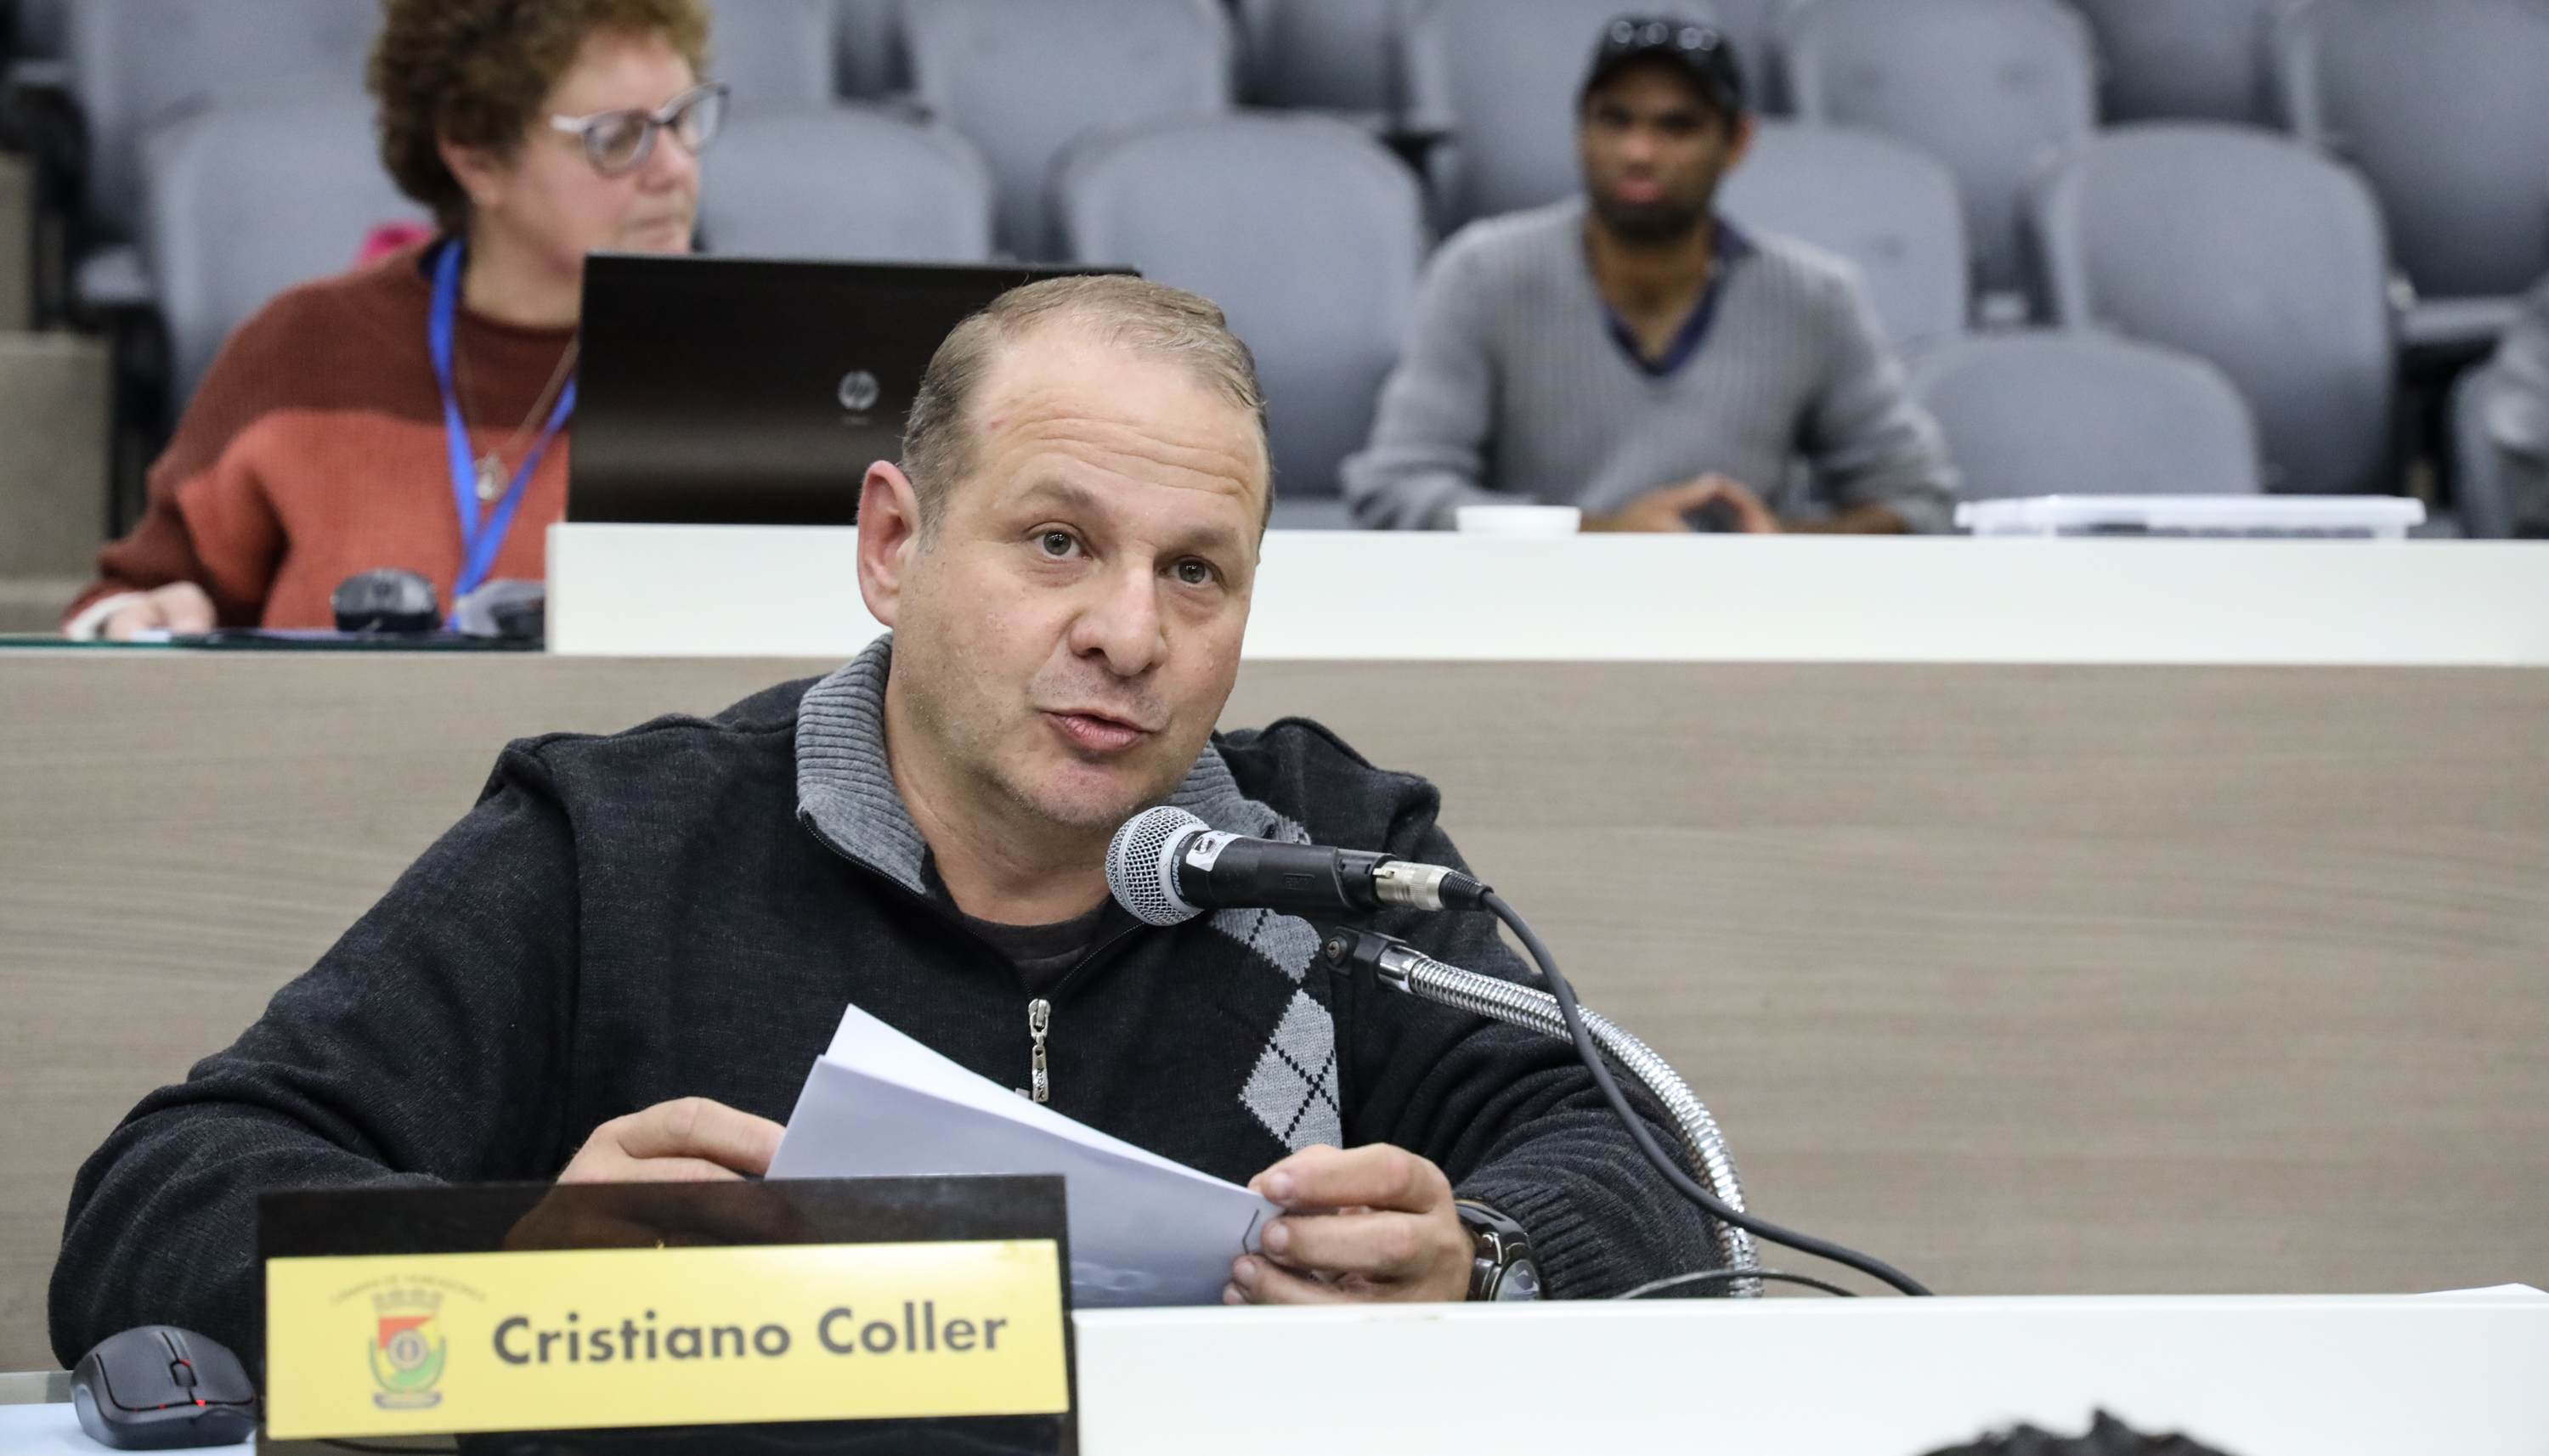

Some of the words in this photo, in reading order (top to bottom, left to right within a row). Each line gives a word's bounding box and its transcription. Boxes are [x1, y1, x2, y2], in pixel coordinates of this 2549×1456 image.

[1173, 855, 1184, 897] SHURE
[493, 1310, 790, 1366] Cristiano
[818, 1301, 1005, 1355] Coller
